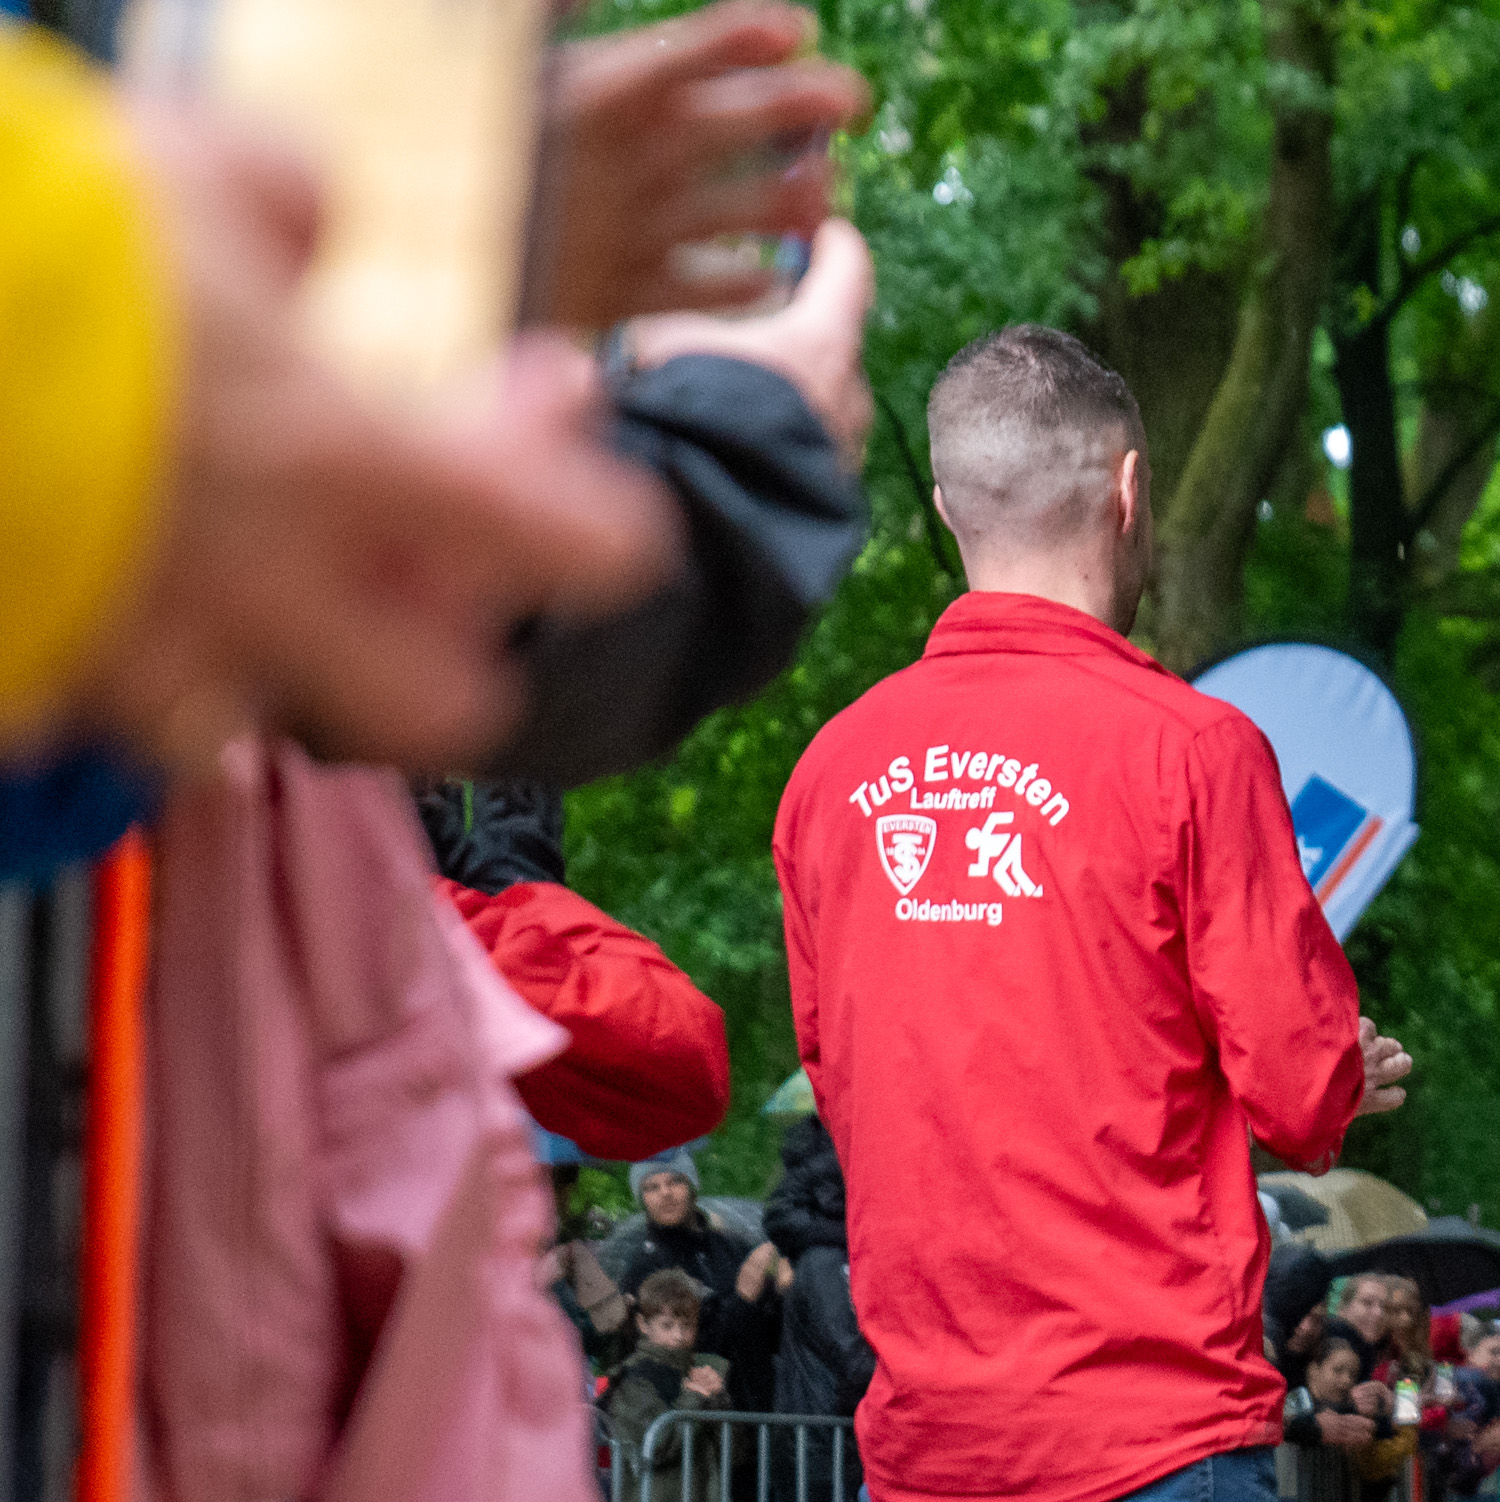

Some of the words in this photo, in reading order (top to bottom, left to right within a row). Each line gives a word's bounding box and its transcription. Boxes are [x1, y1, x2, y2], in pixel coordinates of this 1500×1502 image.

[849, 756, 914, 817] TuS
[924, 744, 1070, 826] Eversten
[910, 786, 997, 810] Lauftreff
[895, 898, 1003, 926] Oldenburg
